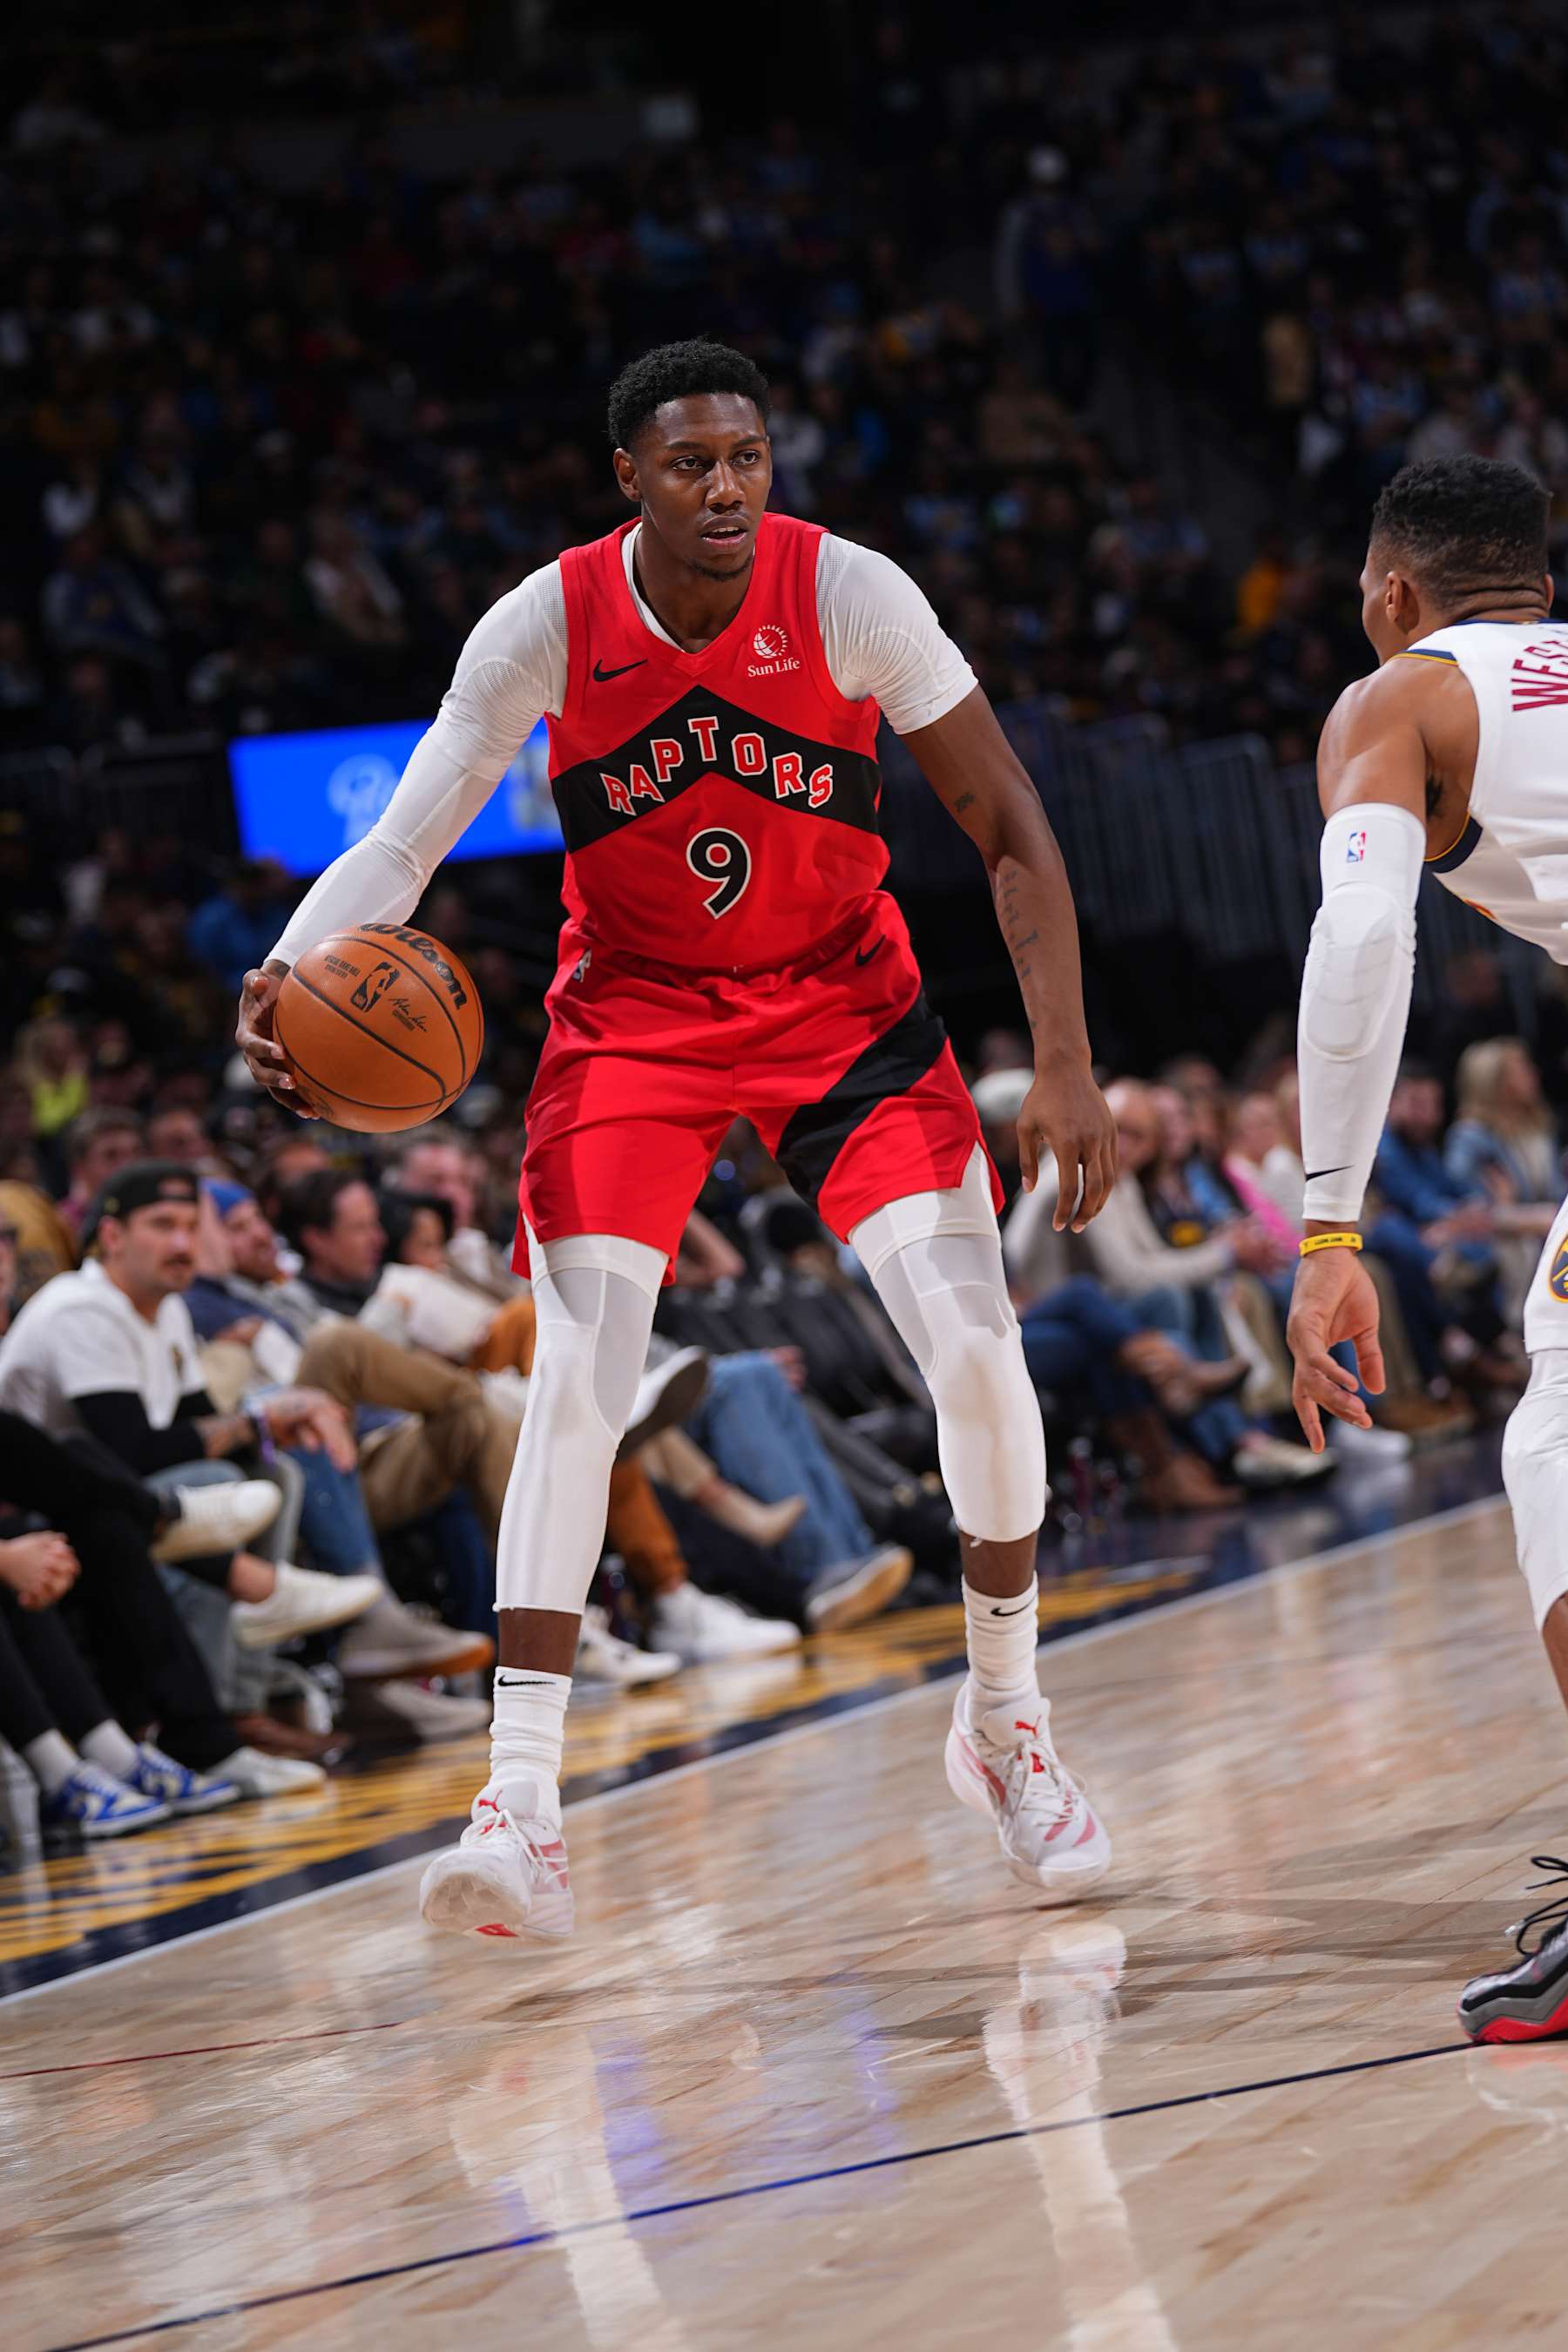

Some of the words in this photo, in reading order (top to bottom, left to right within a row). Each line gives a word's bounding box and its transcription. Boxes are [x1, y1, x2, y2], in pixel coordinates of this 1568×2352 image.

[747, 665, 774, 677] Sun
[775, 657, 801, 672] Life
[600, 716, 833, 815] RAPTORS
[686, 827, 752, 919] 9
